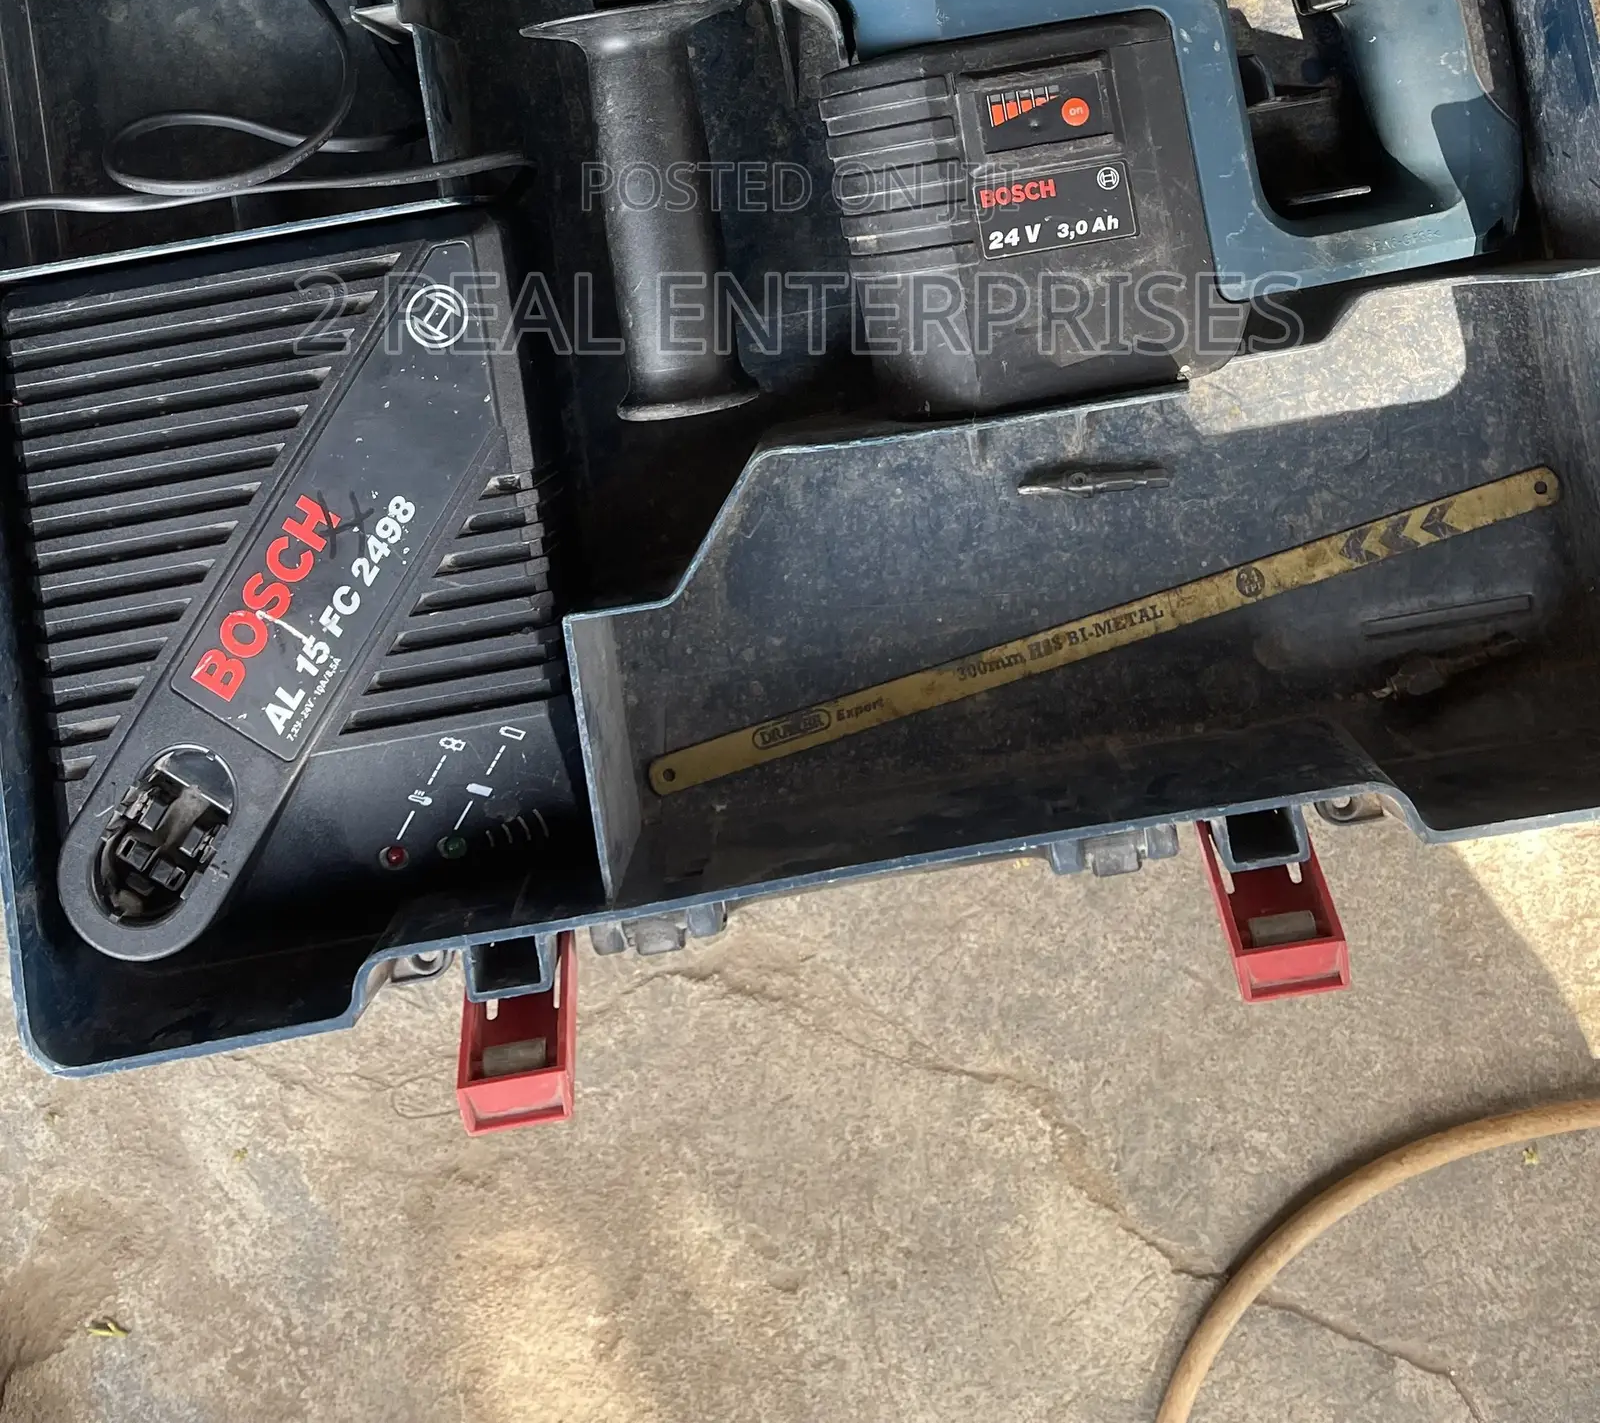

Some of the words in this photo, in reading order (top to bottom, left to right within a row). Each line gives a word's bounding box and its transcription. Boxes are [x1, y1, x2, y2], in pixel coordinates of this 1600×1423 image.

[1069, 106, 1084, 117] on
[980, 178, 1057, 209] BOSCH
[988, 227, 1021, 251] 24
[1025, 223, 1042, 244] V
[1056, 219, 1089, 240] 3,0
[1092, 214, 1119, 234] Ah
[190, 494, 342, 702] BOSCH
[264, 686, 306, 735] AL
[296, 634, 330, 676] 15
[319, 585, 361, 638] FC
[351, 495, 416, 588] 2498
[956, 652, 1026, 682] 300mm
[1067, 604, 1165, 647] BI-METAL
[836, 696, 885, 723] Expert
